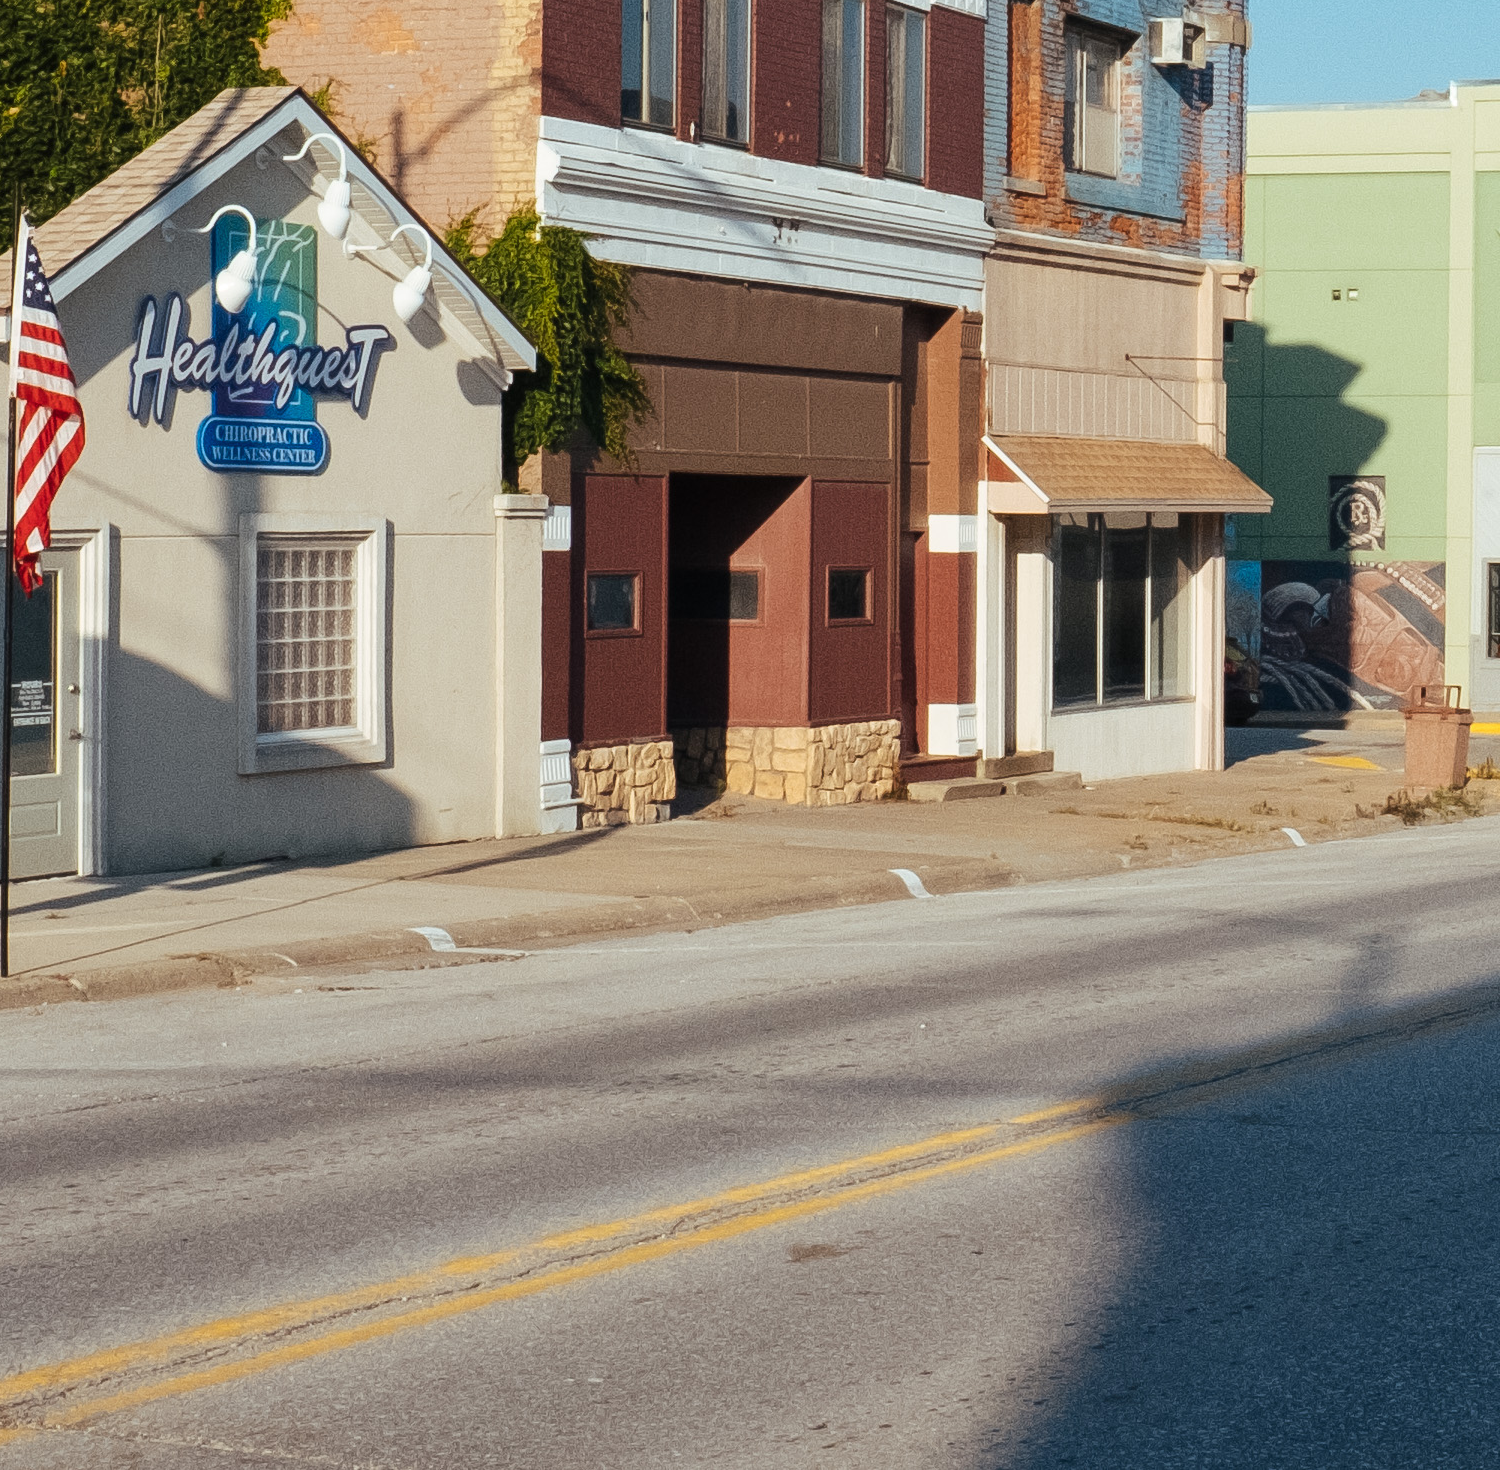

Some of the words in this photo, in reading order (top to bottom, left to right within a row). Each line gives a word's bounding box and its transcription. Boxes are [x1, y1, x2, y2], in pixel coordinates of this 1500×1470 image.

[215, 424, 313, 445] CHIROPRACTIC
[211, 445, 271, 462] WELLNESS
[272, 448, 316, 464] CENTER
